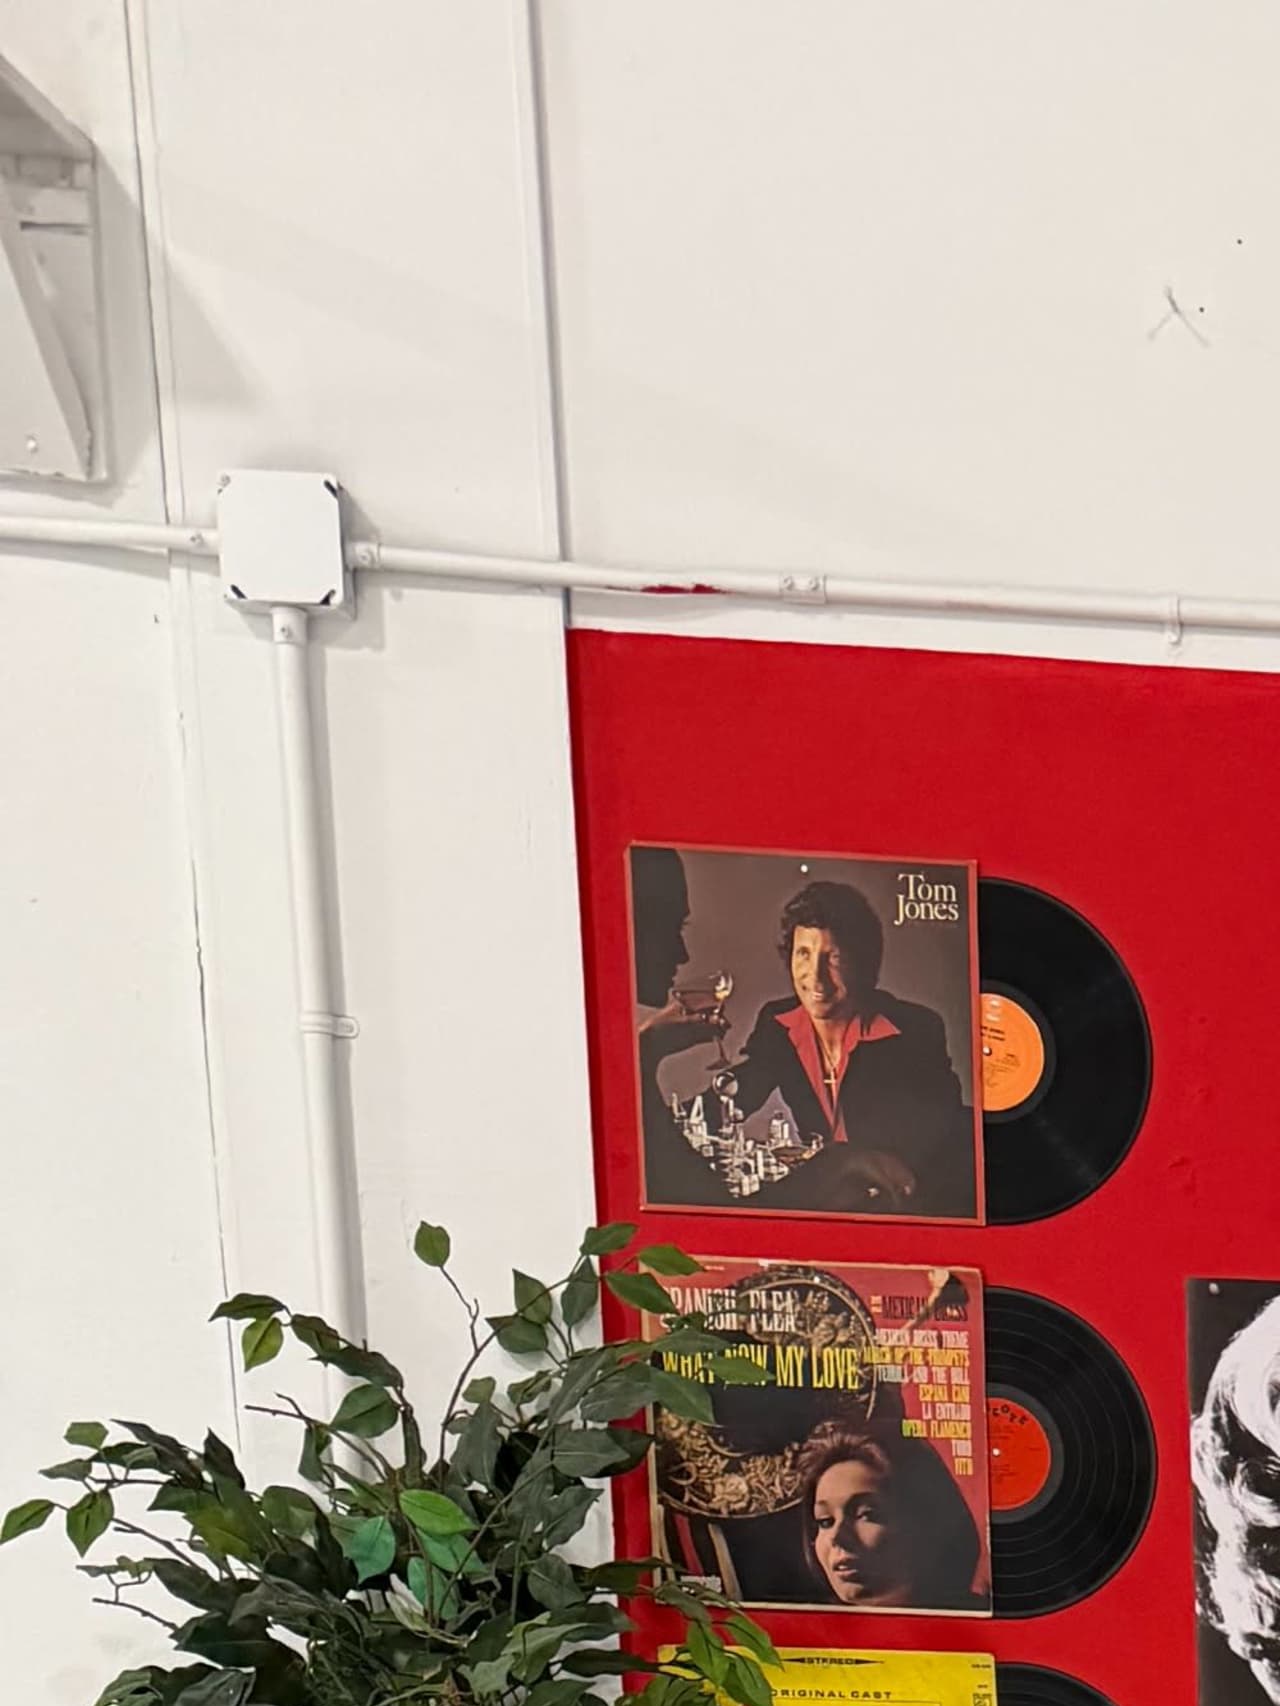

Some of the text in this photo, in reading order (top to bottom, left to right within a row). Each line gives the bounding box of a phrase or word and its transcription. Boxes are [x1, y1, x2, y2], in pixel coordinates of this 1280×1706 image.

[898, 873, 956, 902] Tom
[893, 894, 959, 925] Jones
[776, 1346, 804, 1387] MY
[812, 1347, 859, 1389] LOVE
[851, 1690, 892, 1699] CAST
